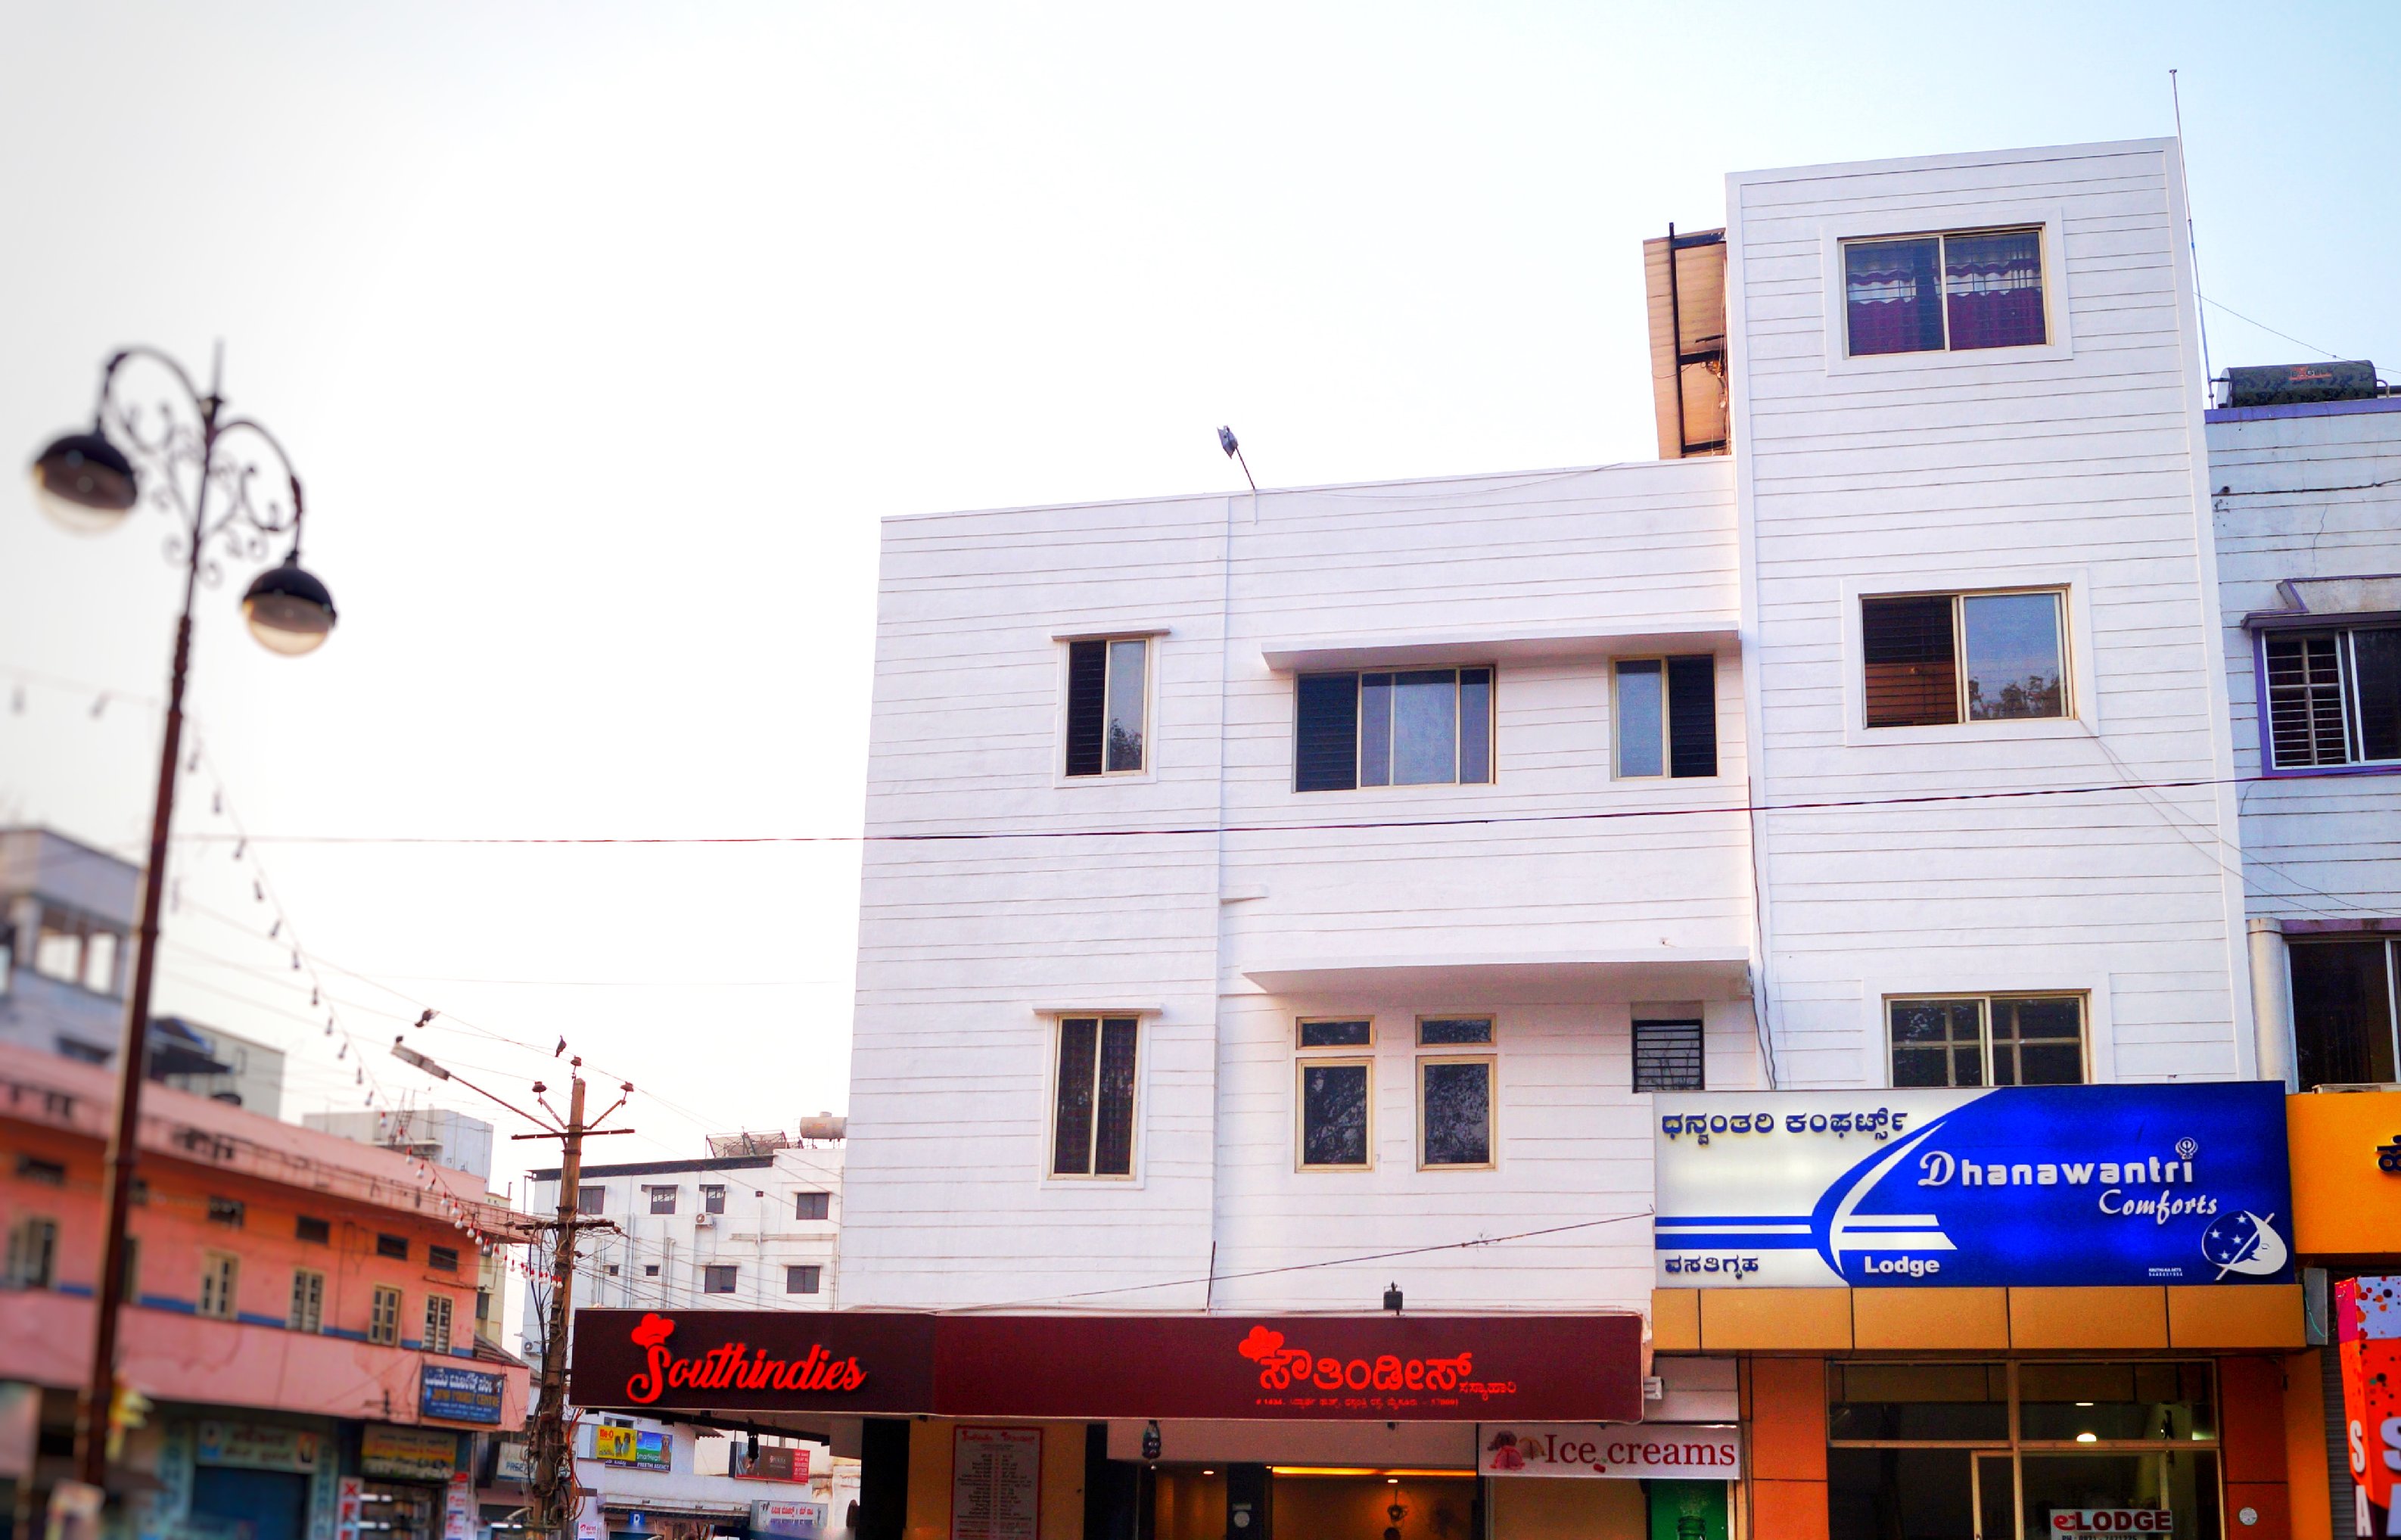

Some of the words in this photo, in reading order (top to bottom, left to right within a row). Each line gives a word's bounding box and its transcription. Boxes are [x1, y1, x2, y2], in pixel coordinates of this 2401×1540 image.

[1662, 1113, 1774, 1145] ಧನ್ವಂತರಿ
[1917, 1148, 2194, 1187] Dhanawantri
[2098, 1188, 2218, 1225] Comforts
[1664, 1255, 1759, 1279] ವಸತಿಗೃಹ
[1864, 1255, 1940, 1278] Lodge
[627, 1342, 868, 1403] Southindies
[1259, 1349, 1473, 1390] ಸೌತಿಂಡೀಸ್
[1544, 1434, 1597, 1464] Ice
[1607, 1442, 1735, 1466] creams
